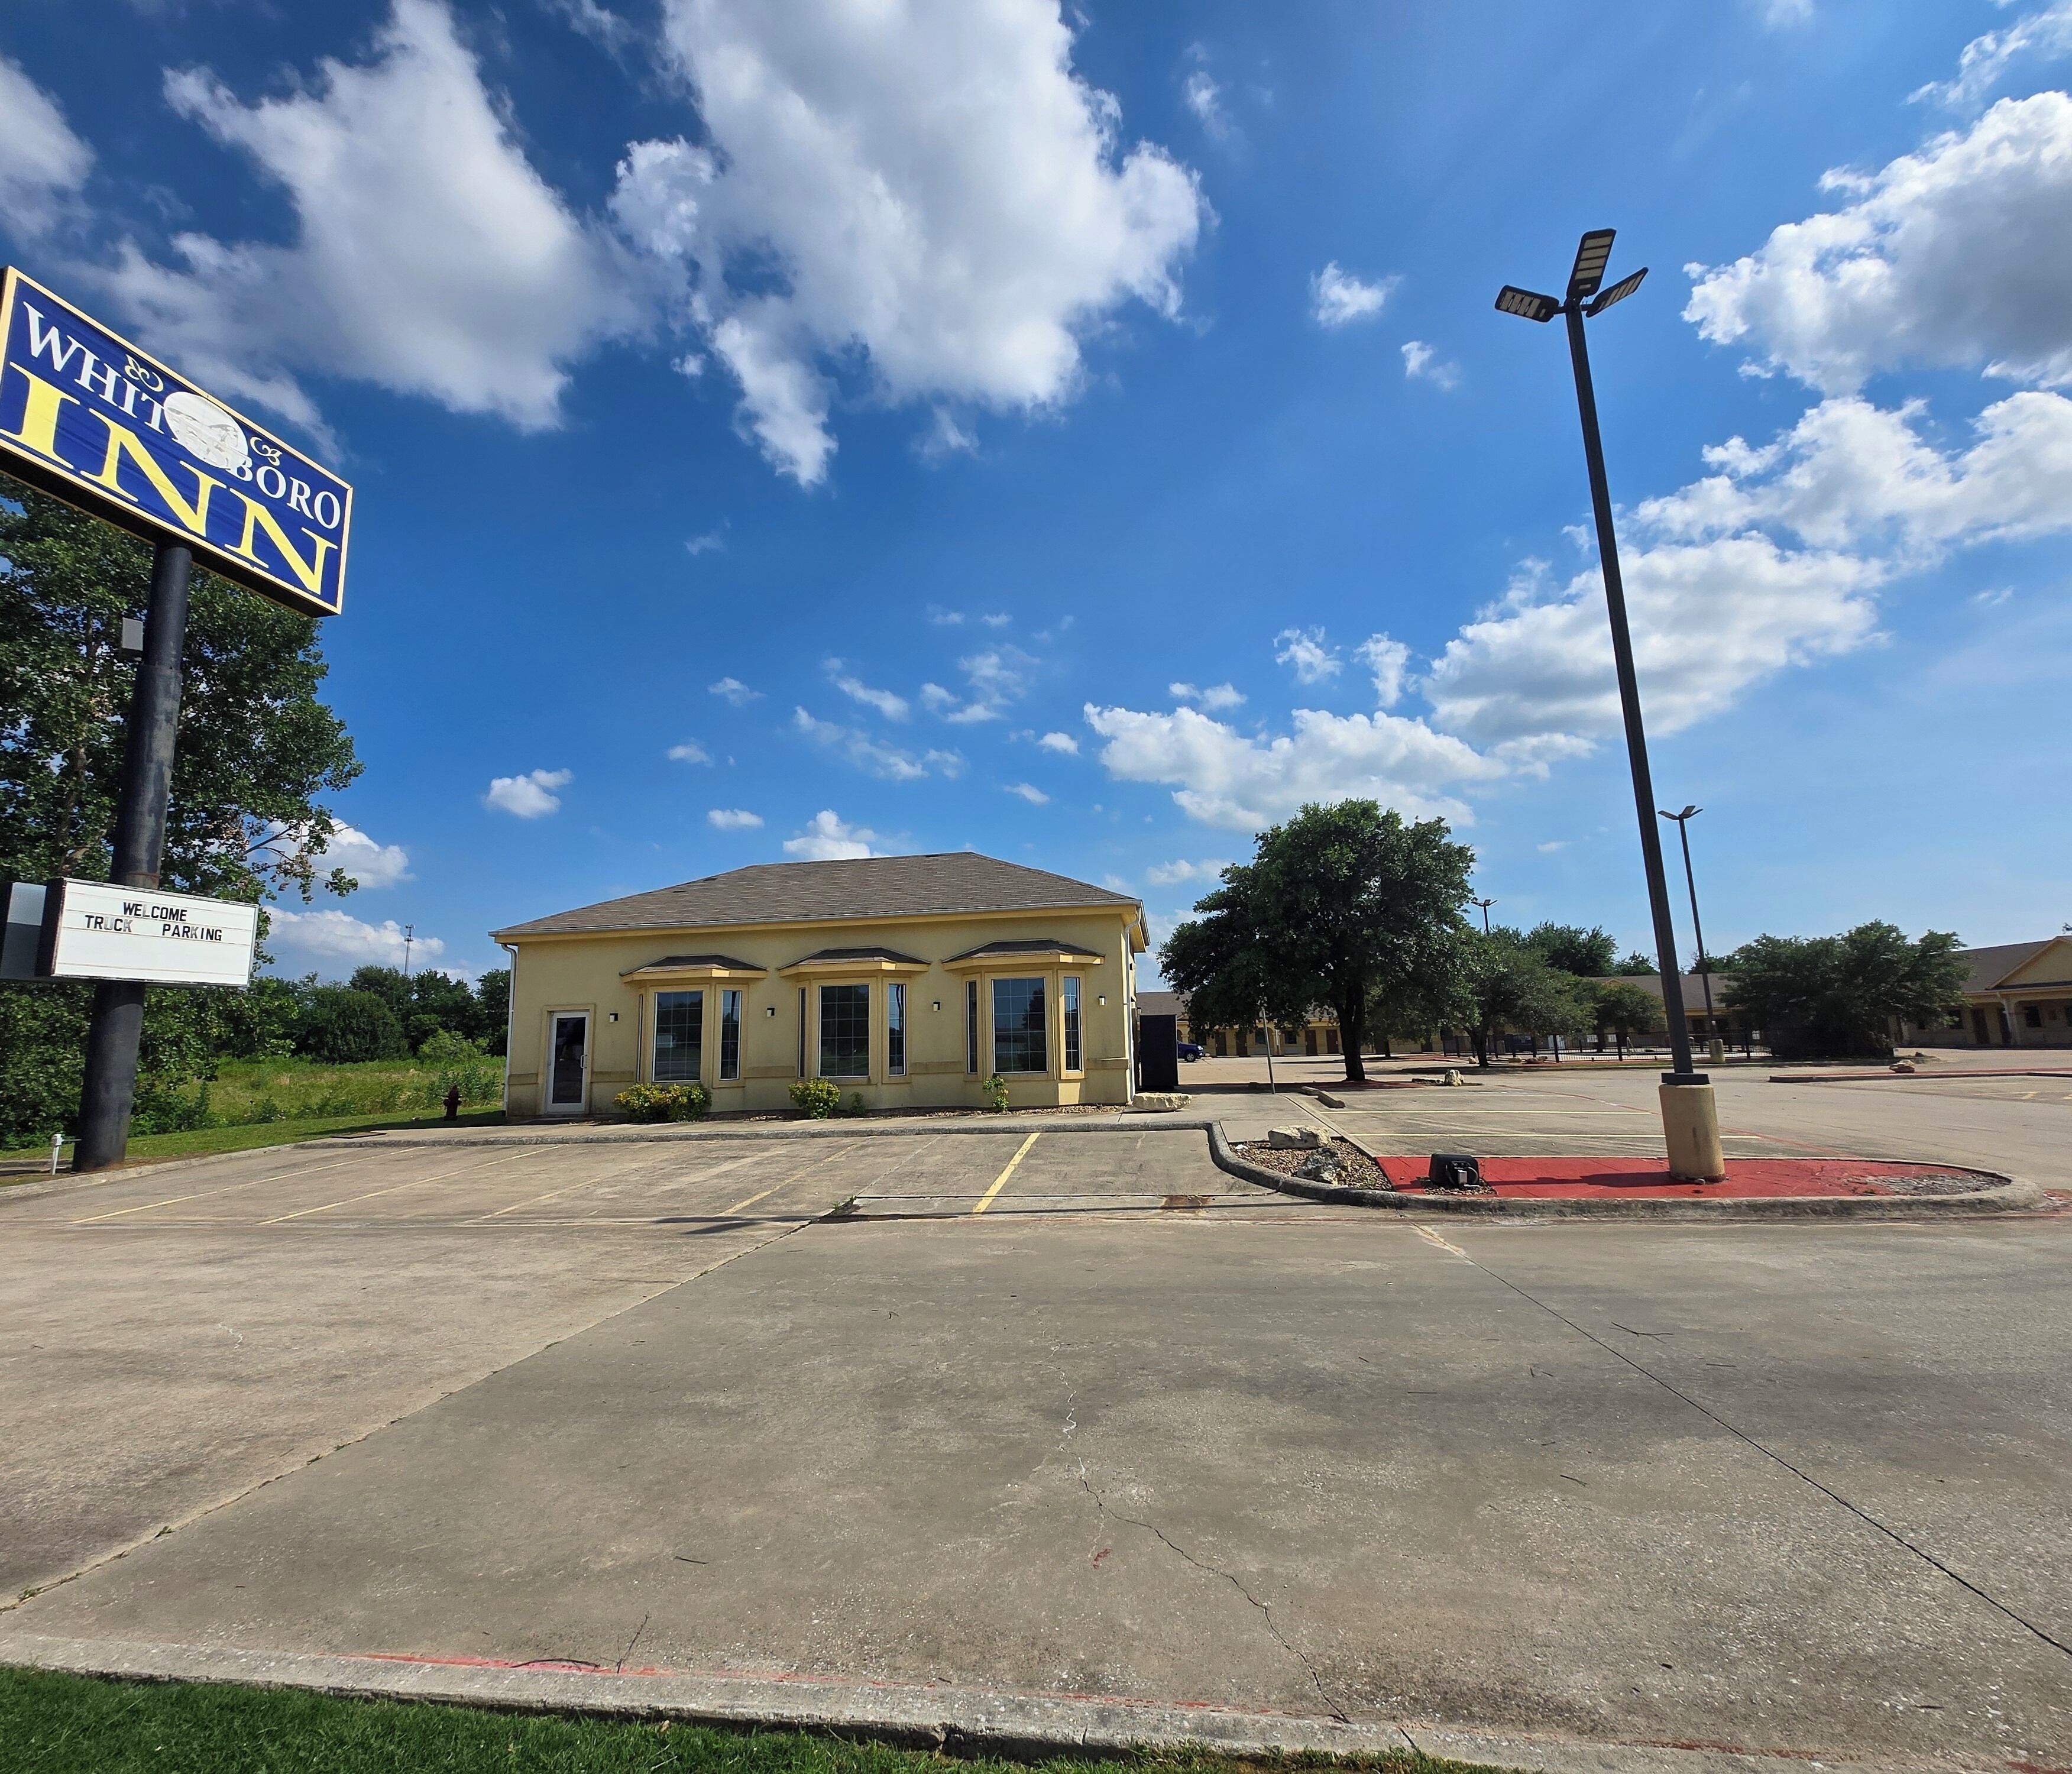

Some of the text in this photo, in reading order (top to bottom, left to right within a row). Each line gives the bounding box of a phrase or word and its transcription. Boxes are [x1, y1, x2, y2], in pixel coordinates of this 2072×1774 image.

[0, 362, 338, 595] INN
[24, 302, 341, 529] WHITBORO
[85, 915, 222, 941] TRUCK PARKING
[123, 902, 187, 922] WELCOME
